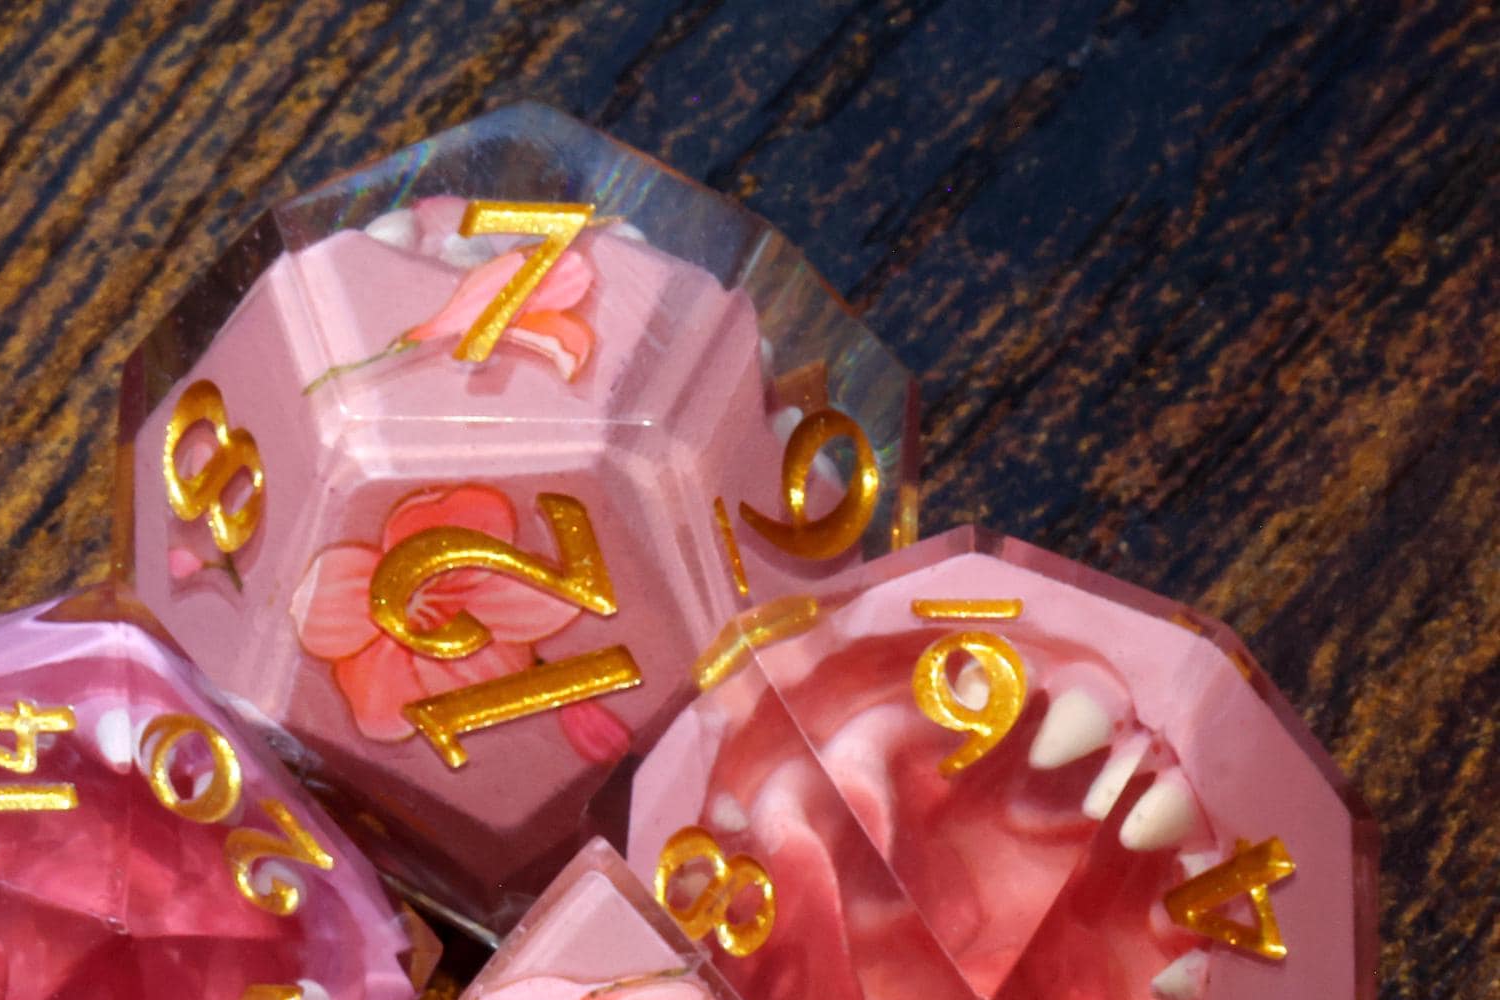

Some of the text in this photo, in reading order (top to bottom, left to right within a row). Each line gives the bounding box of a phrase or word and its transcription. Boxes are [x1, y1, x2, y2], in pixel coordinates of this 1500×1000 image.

[455, 203, 595, 361] 7
[166, 381, 263, 550] 8
[371, 495, 643, 767] 12
[141, 714, 332, 914] 20
[657, 827, 772, 955] 8
[1166, 838, 1293, 960] 4
